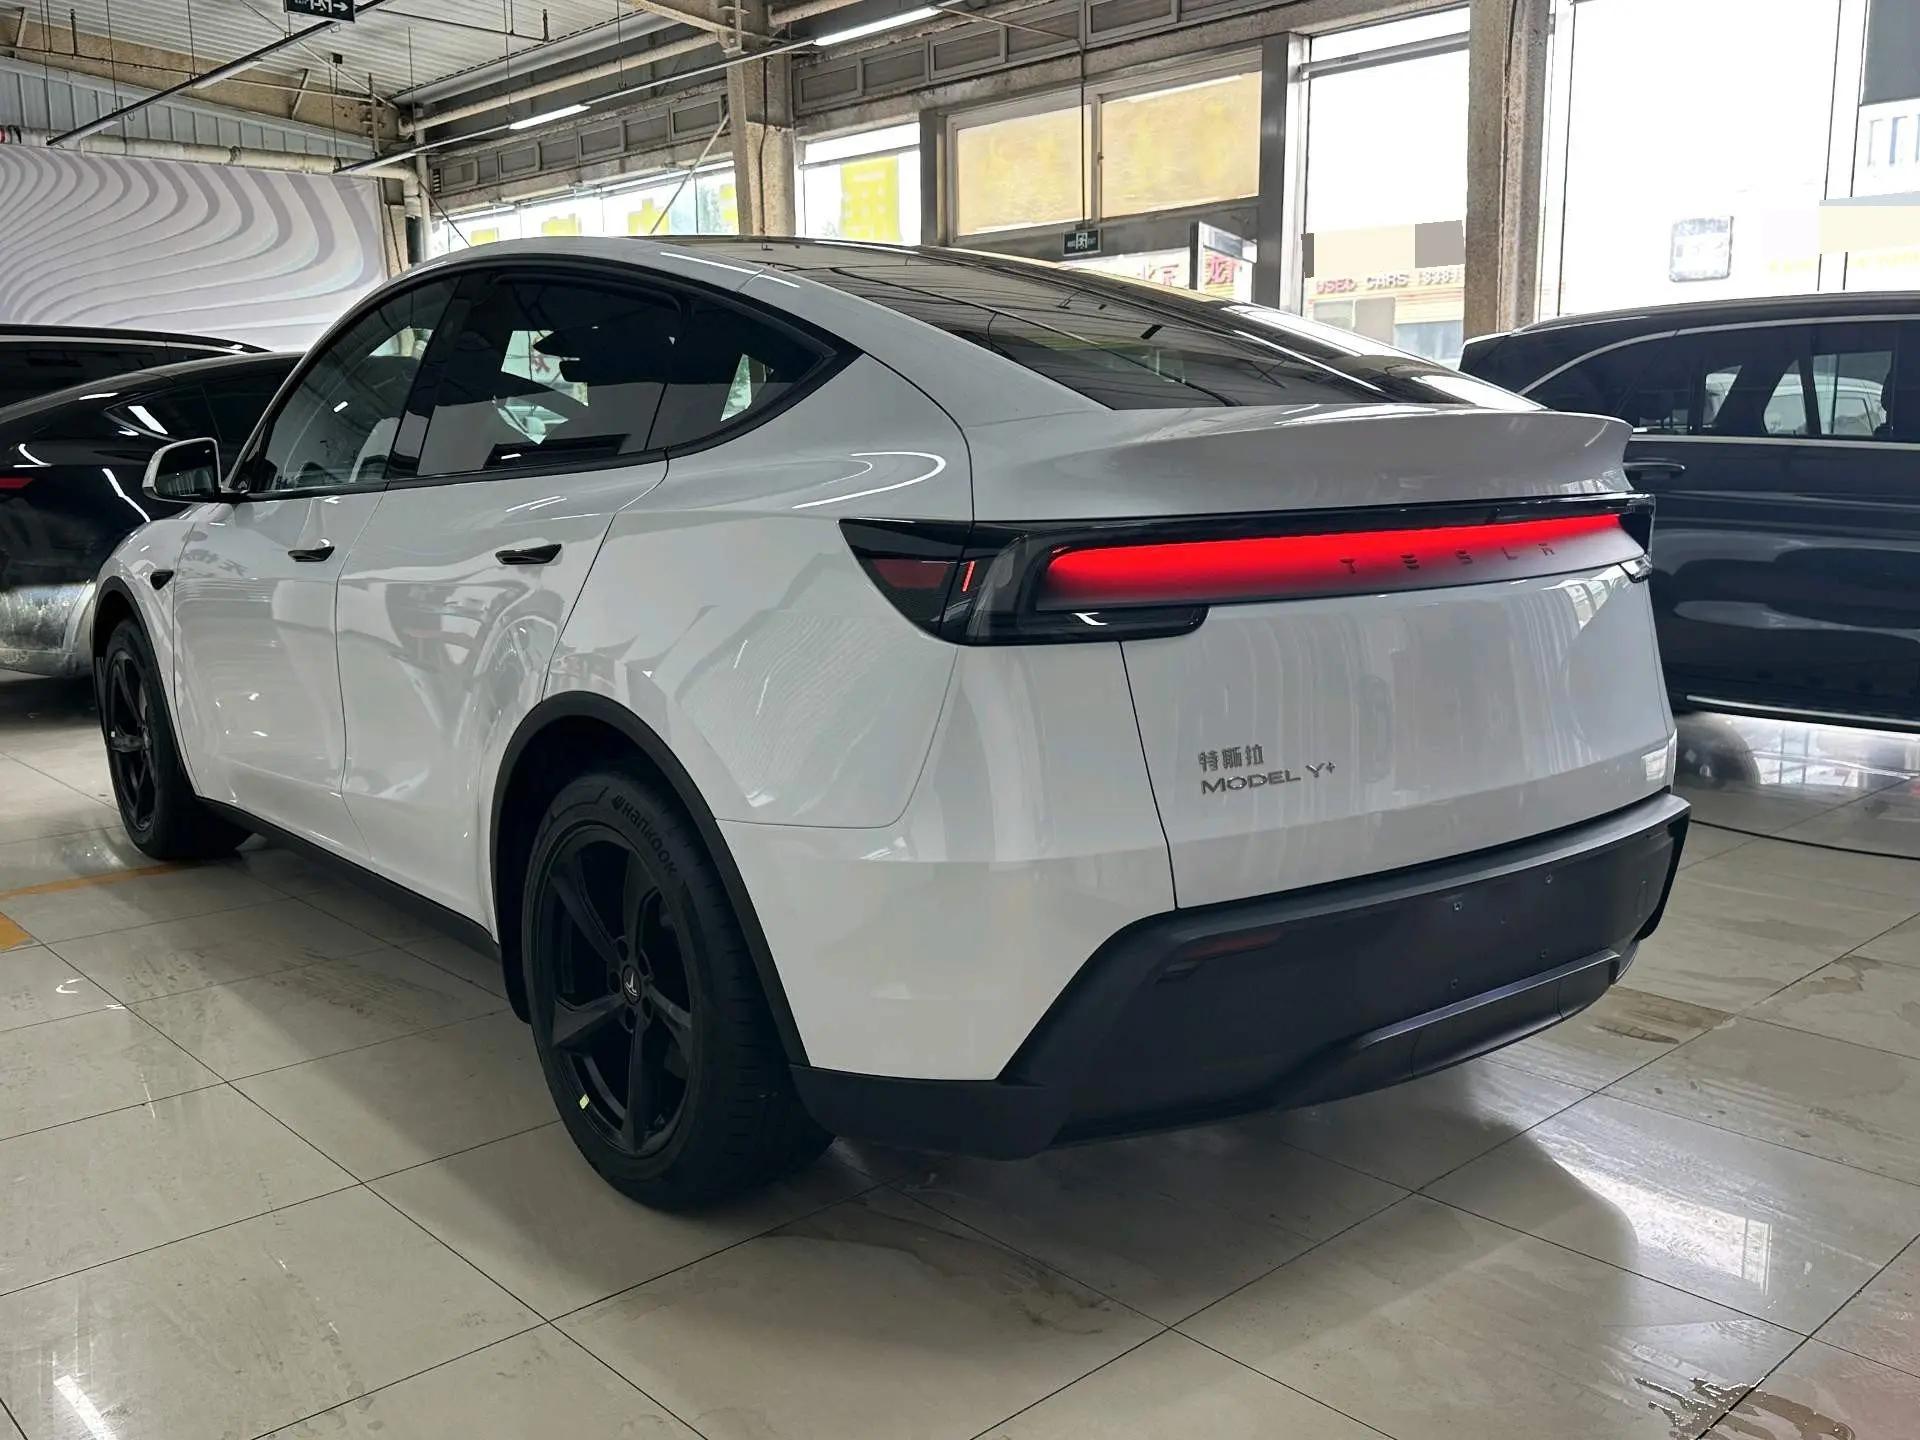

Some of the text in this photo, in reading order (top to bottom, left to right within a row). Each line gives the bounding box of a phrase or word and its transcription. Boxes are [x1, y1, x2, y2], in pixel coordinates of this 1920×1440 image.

[1340, 542, 1556, 574] TESLA
[1198, 744, 1264, 772] 特斯拉
[1200, 770, 1301, 795] MODEL
